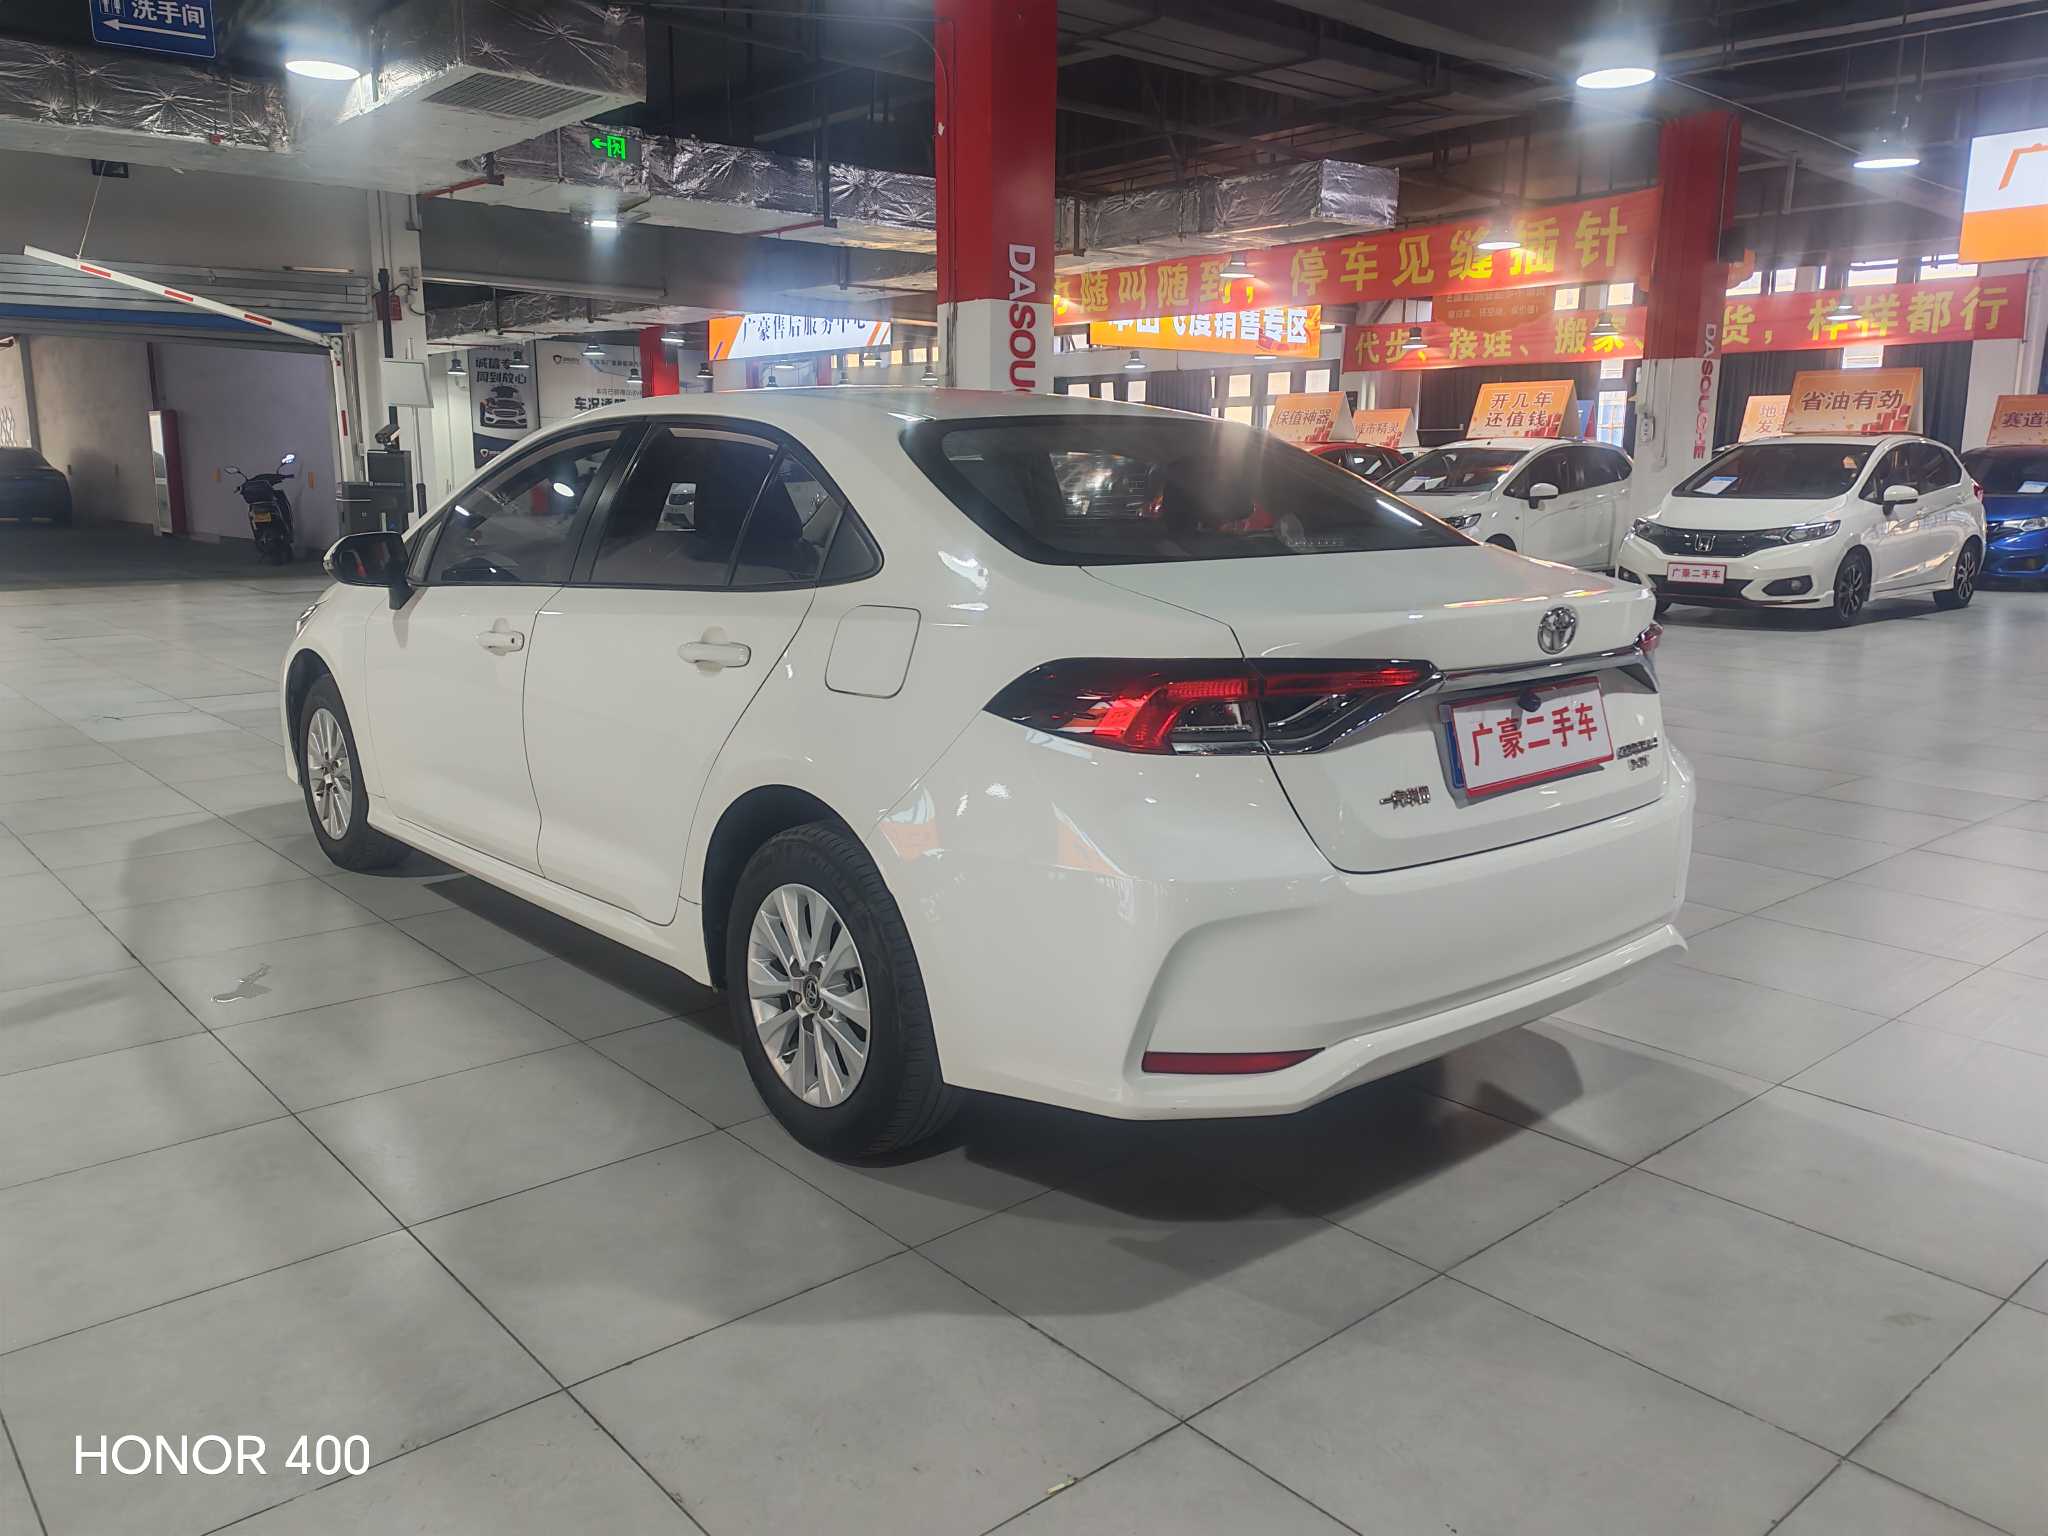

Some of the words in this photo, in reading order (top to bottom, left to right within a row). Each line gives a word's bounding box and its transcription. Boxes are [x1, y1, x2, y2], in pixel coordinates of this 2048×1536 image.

[131, 0, 205, 29] 洗手间
[1008, 243, 1037, 392] DASOU
[1491, 391, 1553, 409] 开几年
[1800, 389, 1904, 412] 省油有劲
[1484, 410, 1547, 427] 还值钱
[2001, 411, 2048, 428] 赛道
[1471, 702, 1598, 767] 广豪二手车
